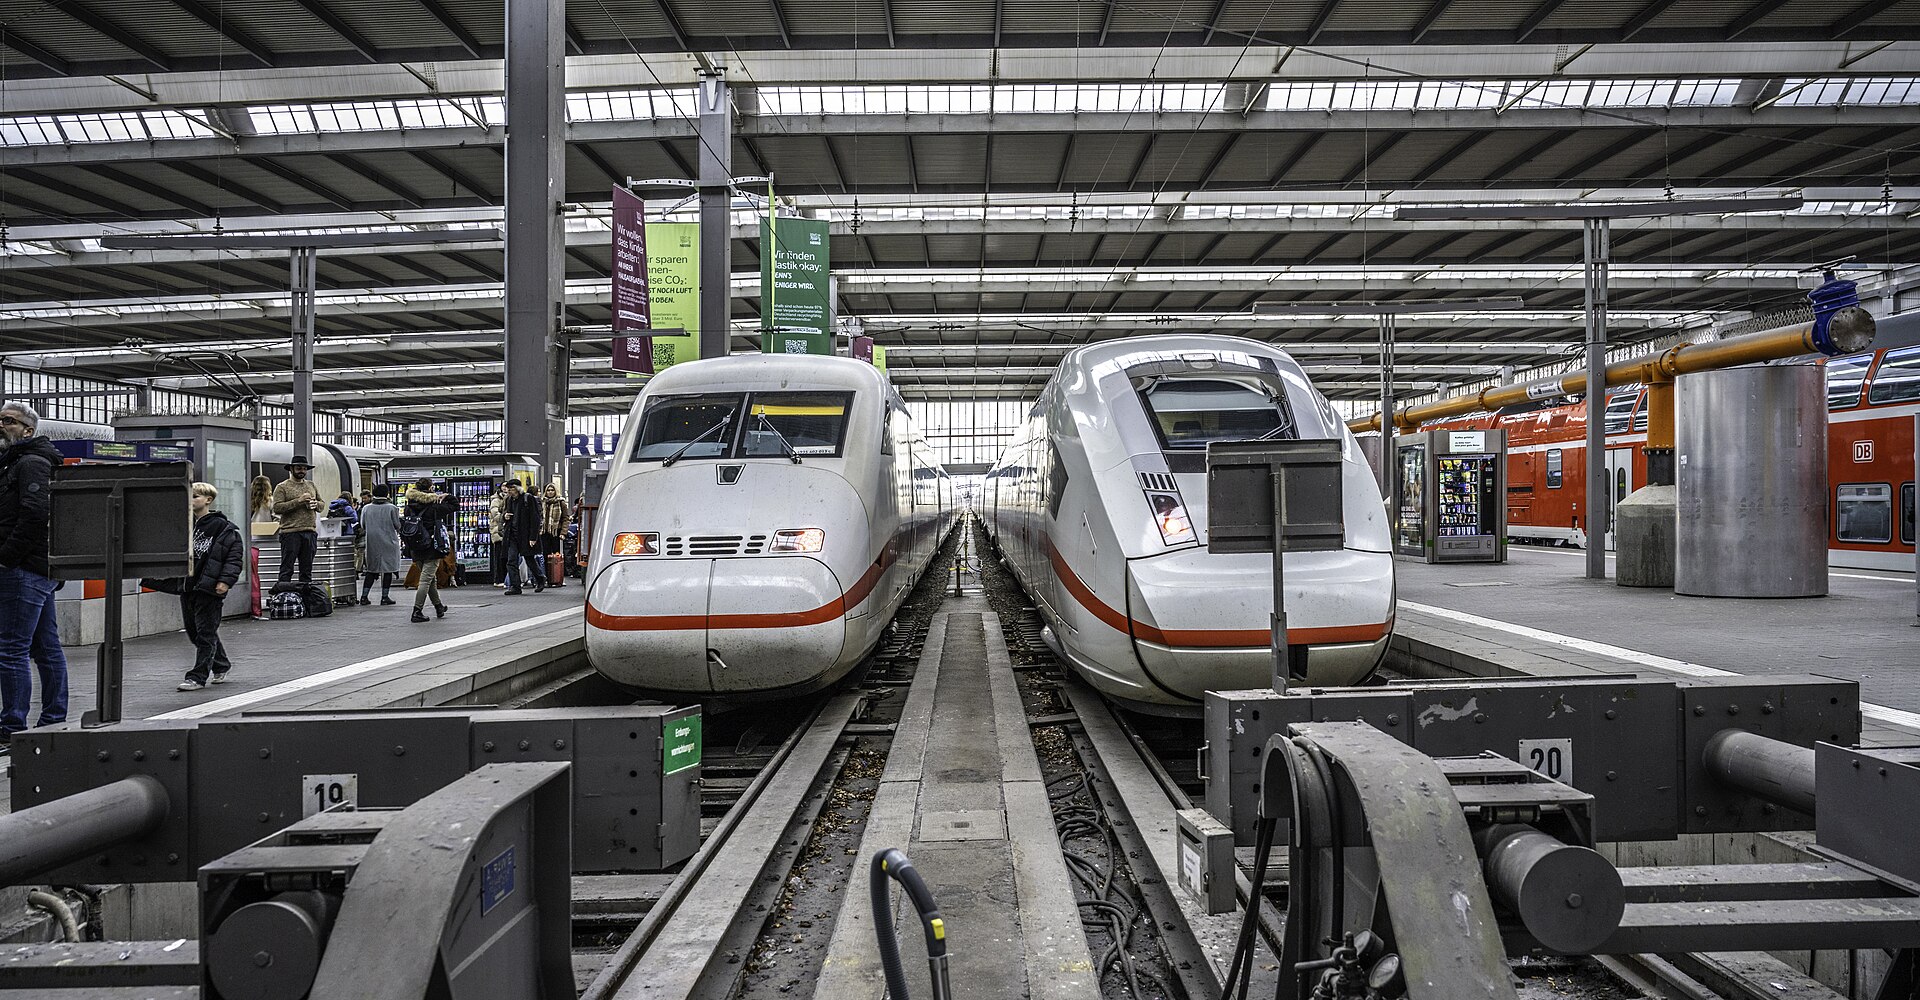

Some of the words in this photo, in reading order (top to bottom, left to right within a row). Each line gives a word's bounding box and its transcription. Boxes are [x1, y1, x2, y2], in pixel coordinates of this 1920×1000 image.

[617, 222, 626, 235] Wir
[626, 229, 643, 244] wollen,
[617, 236, 629, 248] dass
[629, 240, 644, 254] Kinder
[617, 249, 640, 264] arbeiten:
[655, 256, 688, 265] sparen
[787, 250, 815, 260] finden
[775, 260, 798, 270] lastik
[798, 261, 822, 273] okay:
[775, 271, 793, 279] ENN'S
[775, 281, 798, 289] ENIGER
[798, 281, 815, 290] WIRD.
[655, 296, 675, 304] OBEN.
[1856, 444, 1871, 459] DB
[432, 466, 482, 477] zoells.de
[1531, 747, 1562, 779] 20
[314, 782, 343, 812] 19
